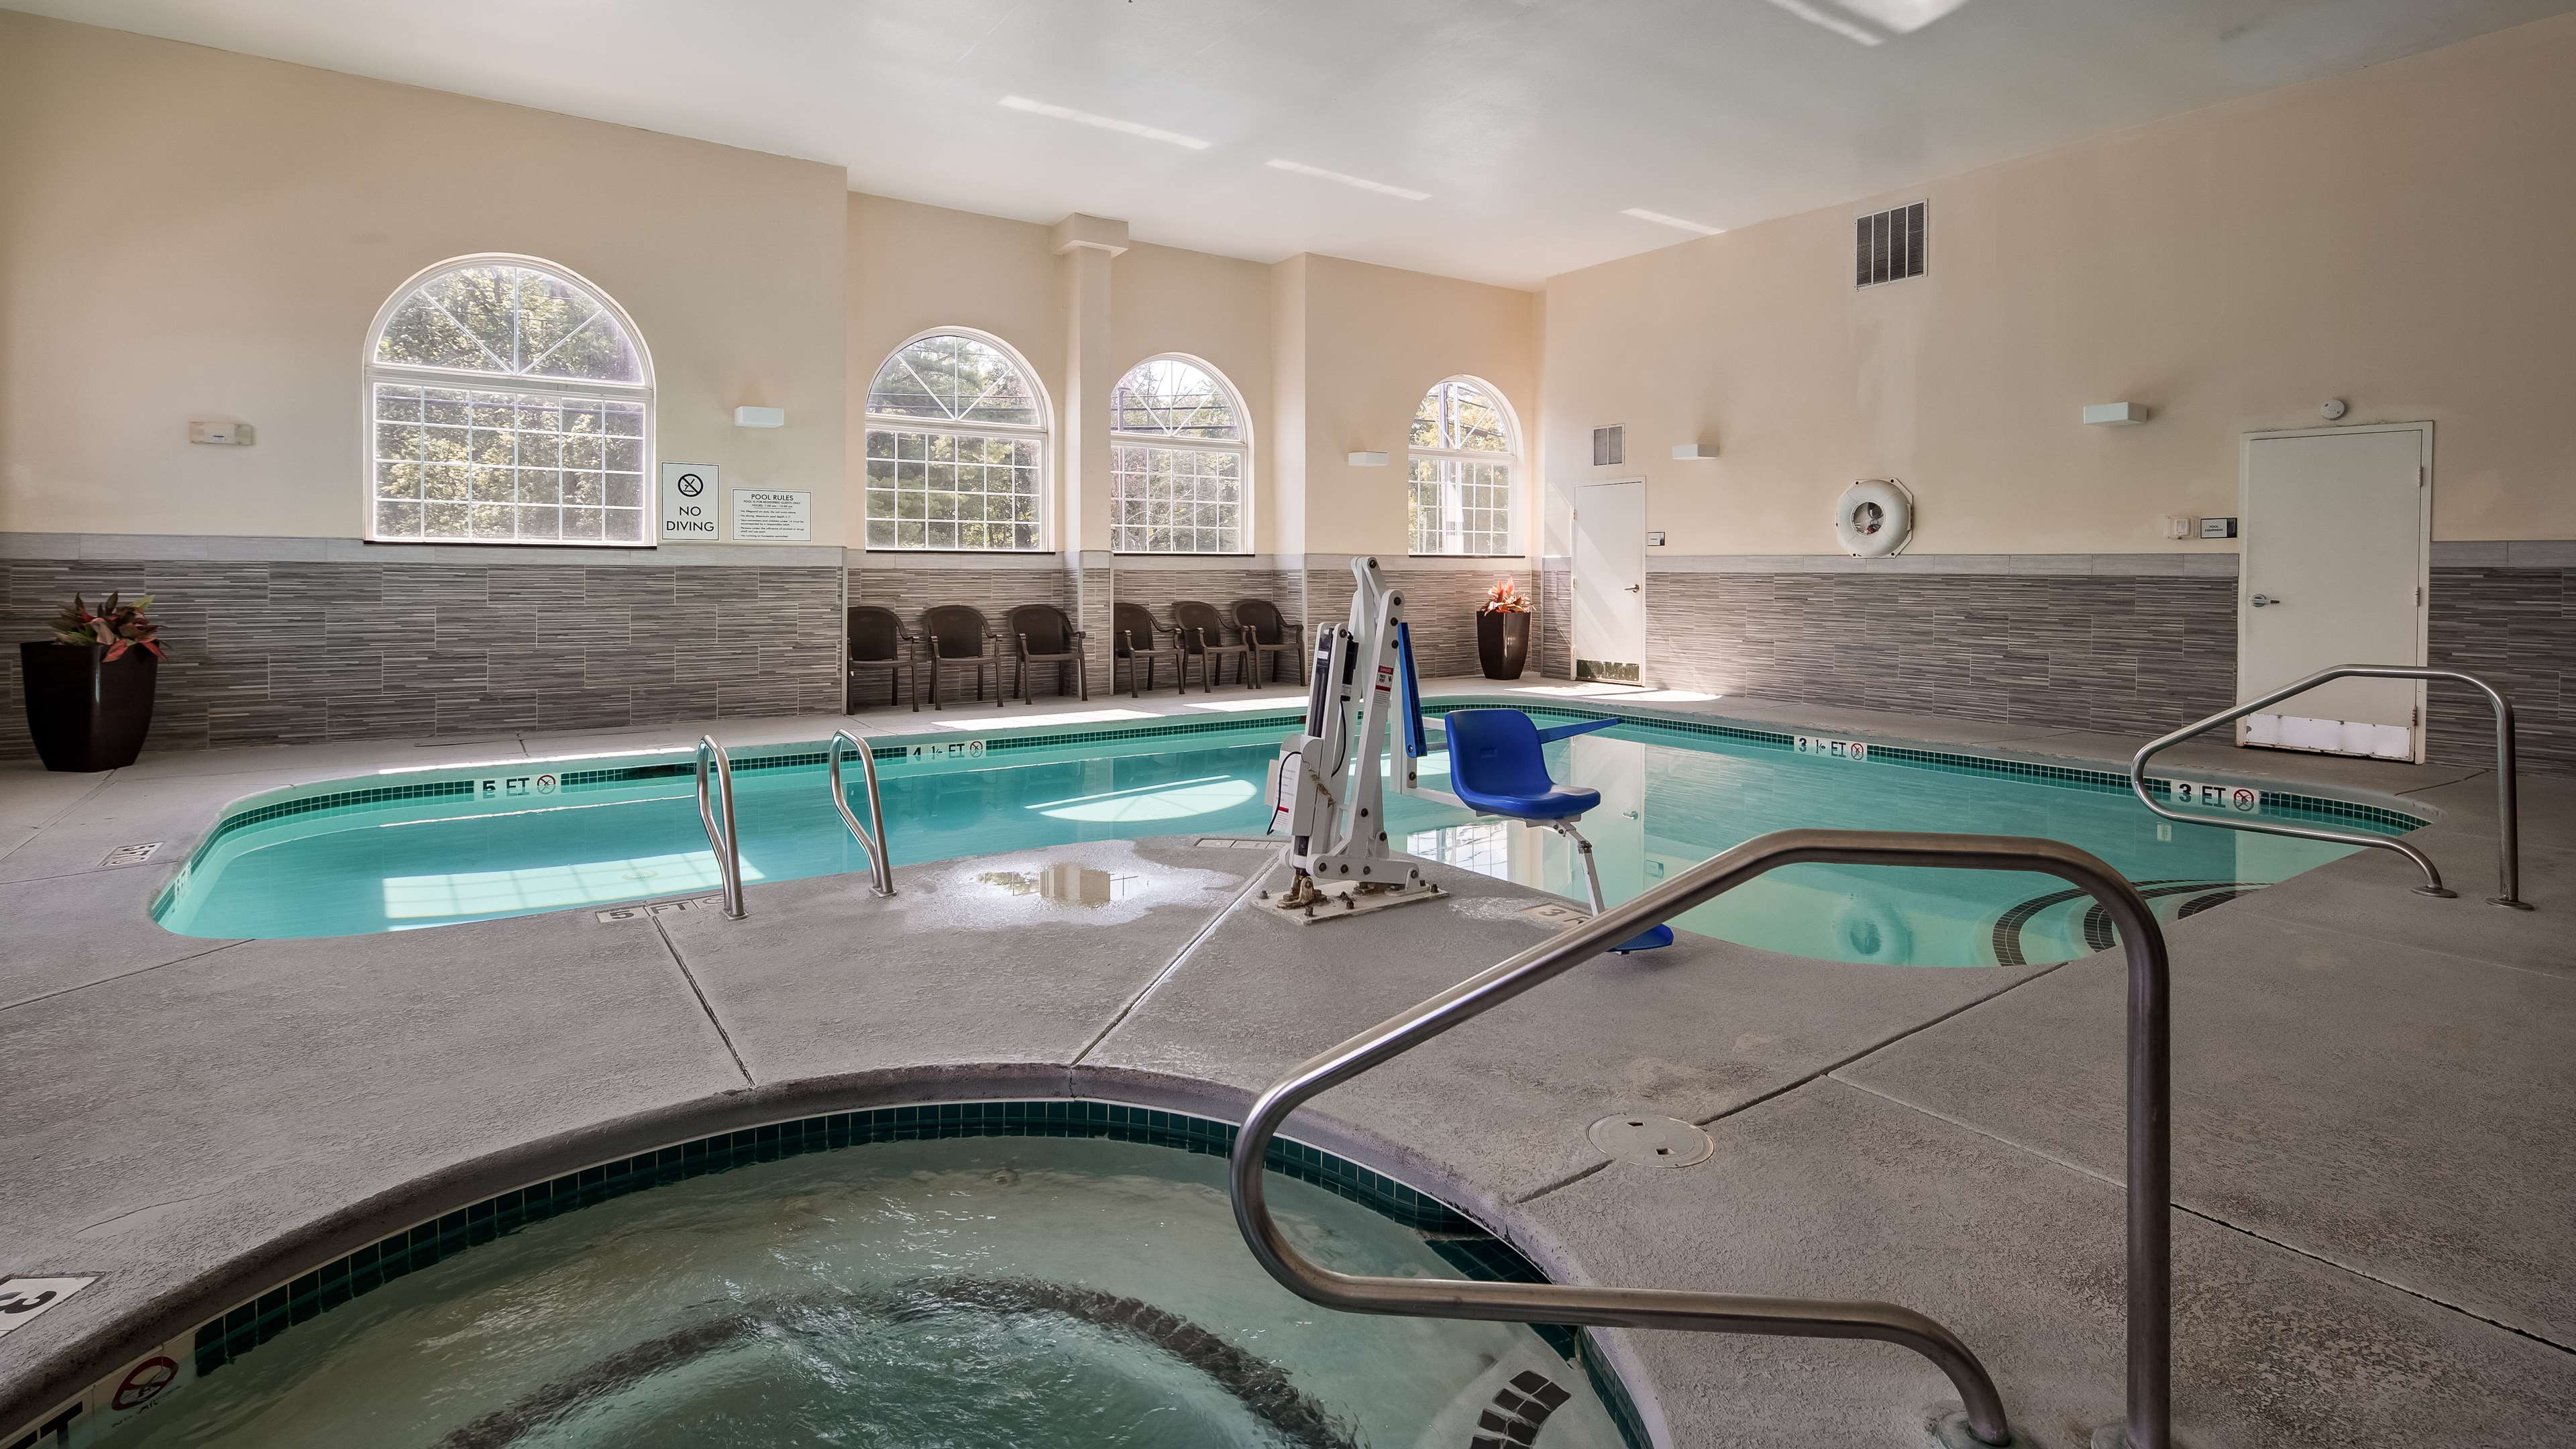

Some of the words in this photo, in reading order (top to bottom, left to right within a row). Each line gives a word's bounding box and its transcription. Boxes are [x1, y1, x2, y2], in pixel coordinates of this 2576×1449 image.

[679, 506, 701, 516] NO
[666, 521, 714, 532] DIVING
[482, 780, 496, 792] 5
[506, 777, 530, 791] FT
[2179, 784, 2192, 795] 3
[610, 910, 635, 919] 5
[650, 902, 690, 914] FT
[1538, 908, 1566, 916] 3
